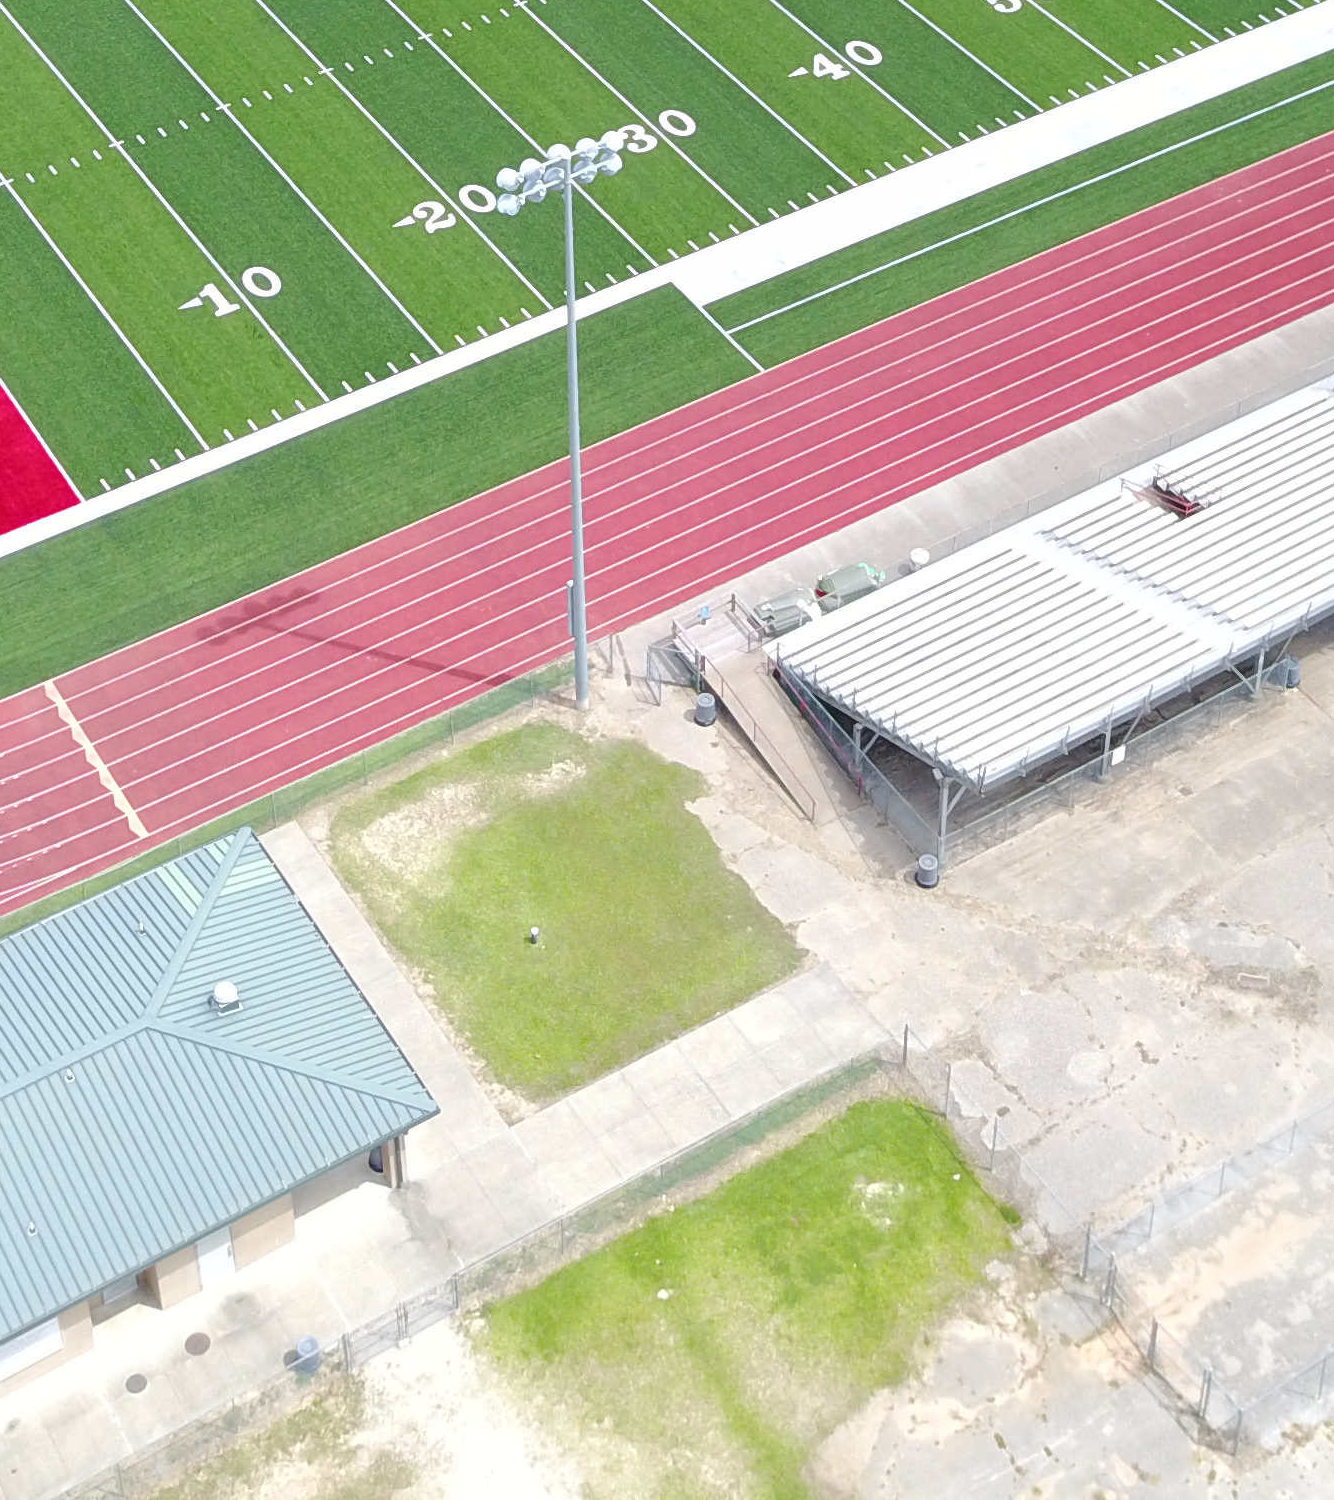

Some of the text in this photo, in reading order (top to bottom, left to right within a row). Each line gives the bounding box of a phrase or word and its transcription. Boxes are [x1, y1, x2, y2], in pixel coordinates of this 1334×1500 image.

[809, 39, 883, 83] 40
[411, 184, 497, 234] 20
[199, 266, 282, 318] 10
